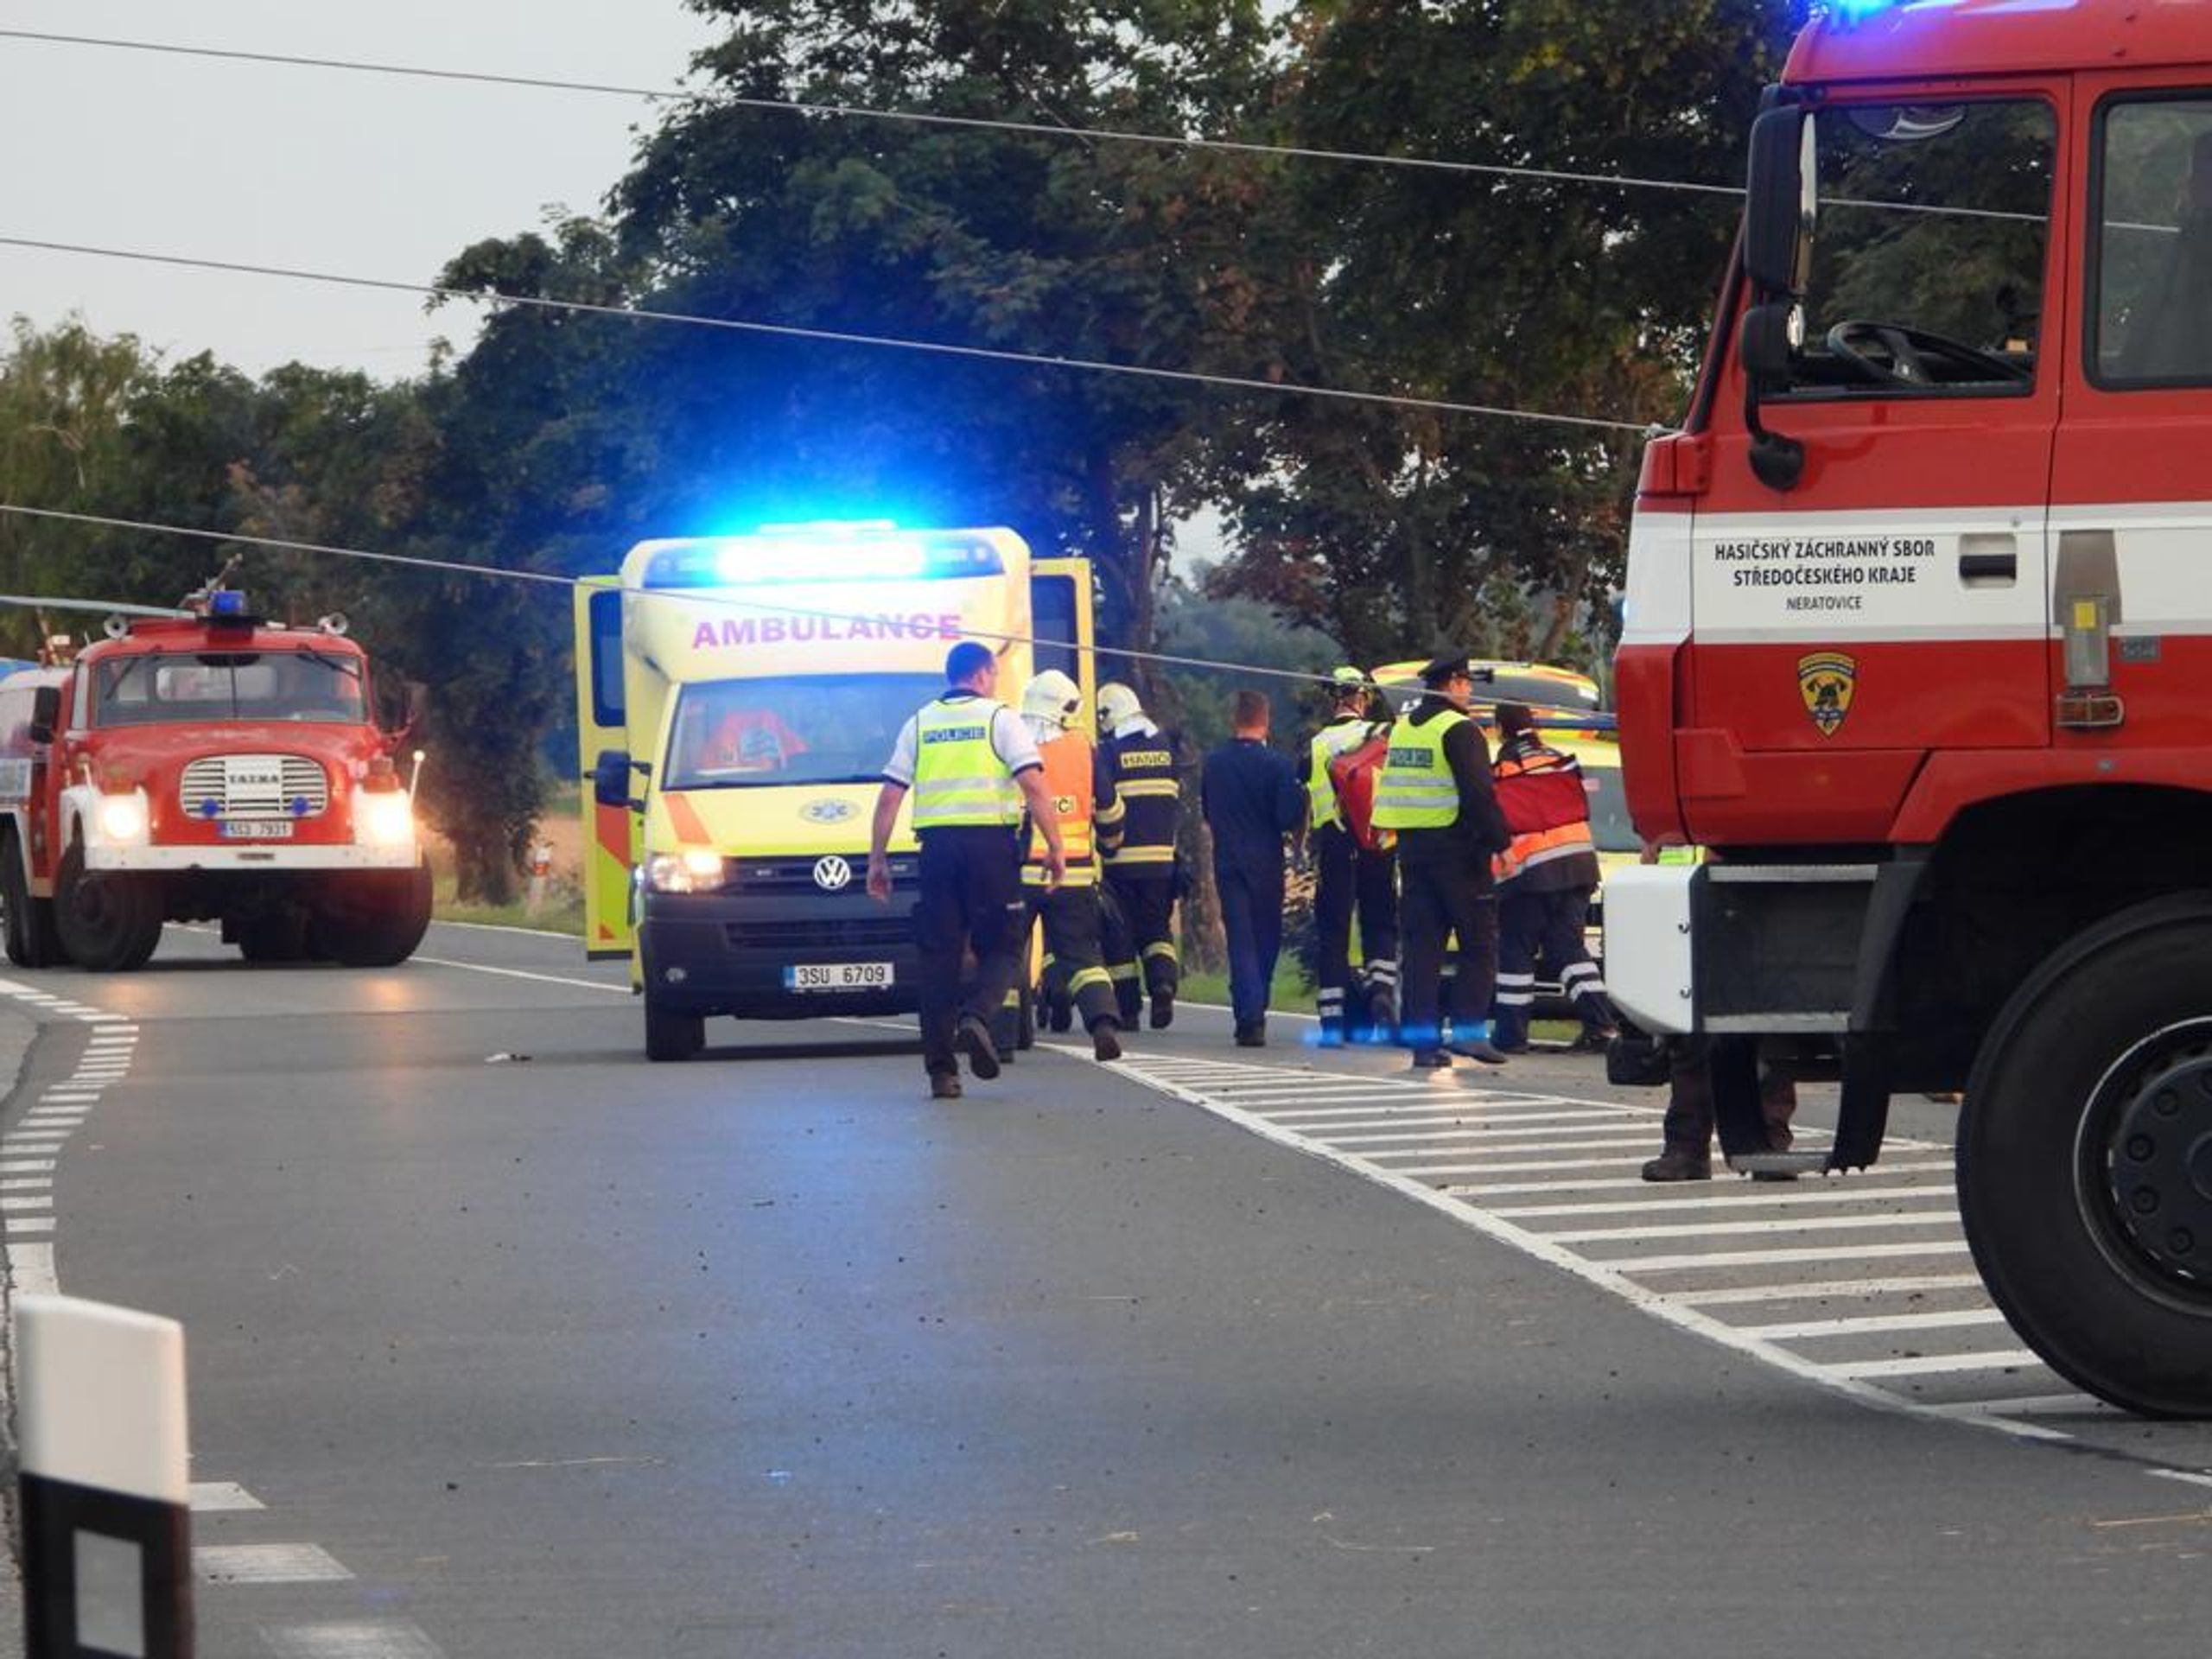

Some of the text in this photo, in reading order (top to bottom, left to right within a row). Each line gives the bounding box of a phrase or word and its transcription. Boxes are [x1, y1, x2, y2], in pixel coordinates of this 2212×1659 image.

[1715, 536, 1936, 560] HASIČSKÝ ZÁCHRANNÝ SBOR
[1733, 565, 1916, 587] STŘEDOČESKÉHO KRAJE
[1786, 595, 1863, 610] NERATOVICE
[692, 613, 963, 650] AMBULANCE
[798, 965, 886, 986] 3SU 6709
